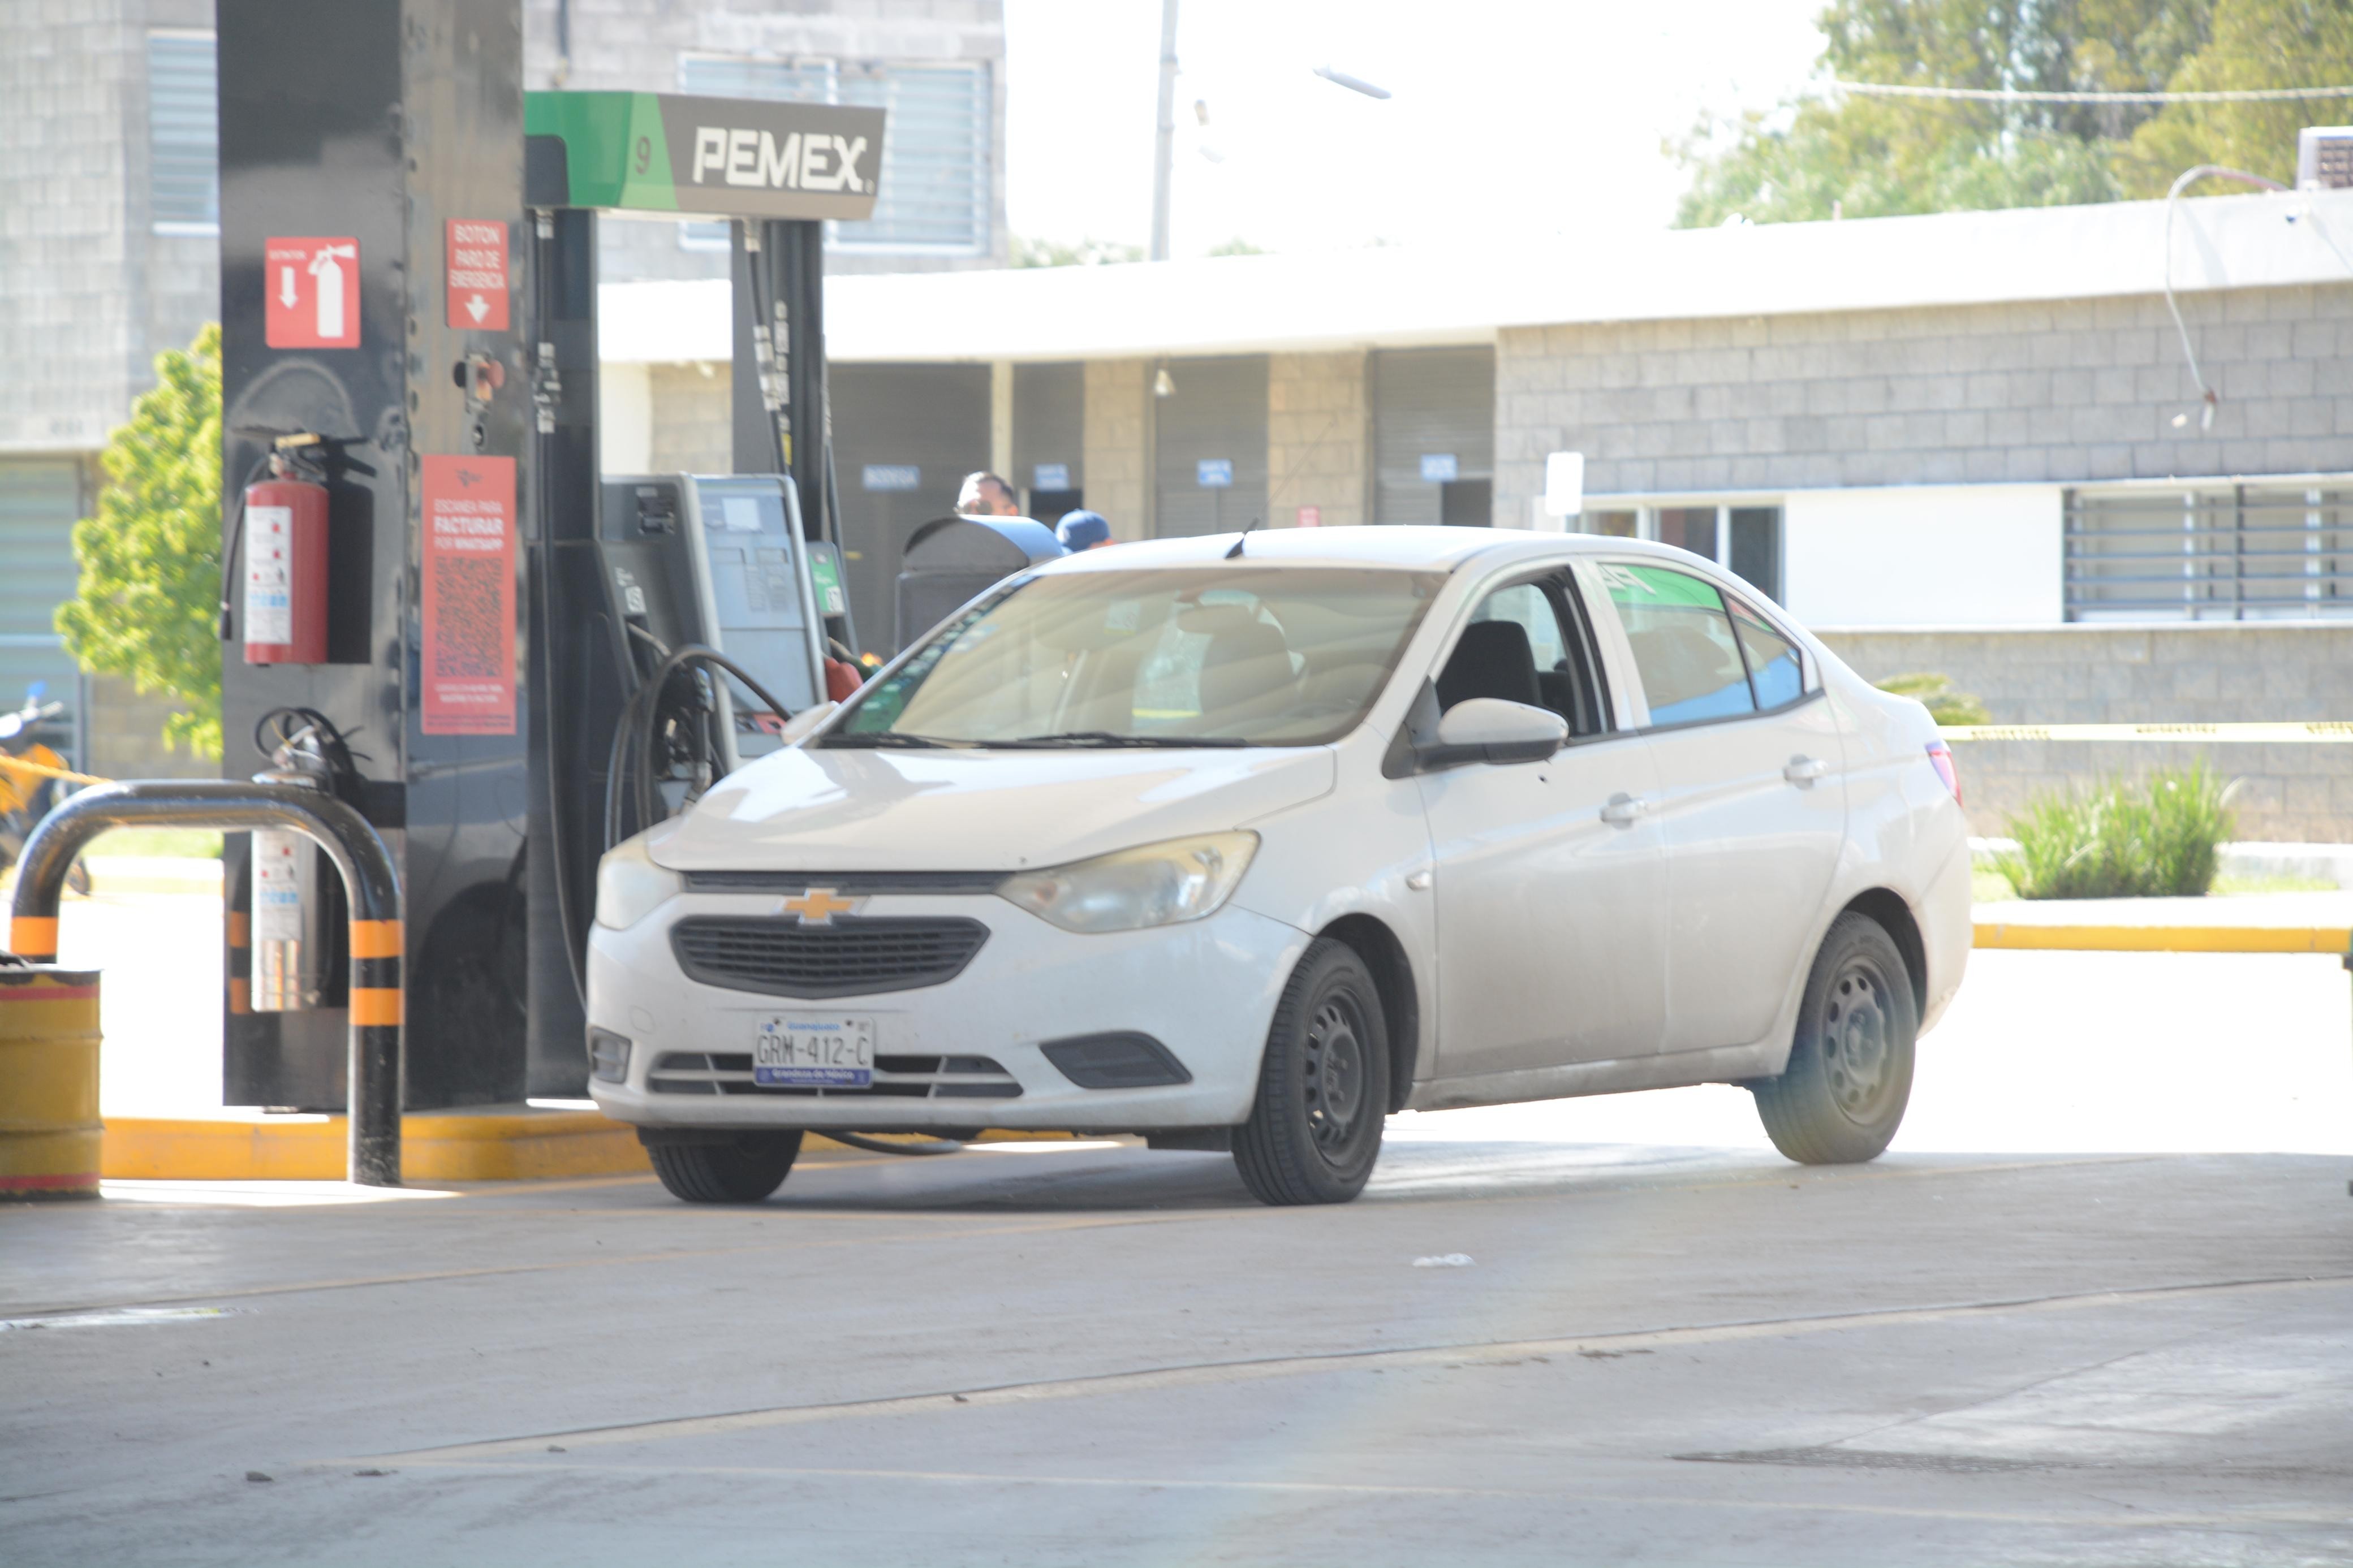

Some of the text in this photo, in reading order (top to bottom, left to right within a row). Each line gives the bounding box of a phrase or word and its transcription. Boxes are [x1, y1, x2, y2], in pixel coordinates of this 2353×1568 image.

[636, 136, 651, 175] 9
[693, 126, 869, 193] PEMEX
[434, 516, 503, 534] FACTURAR
[758, 1035, 869, 1065] GRM-412-C
